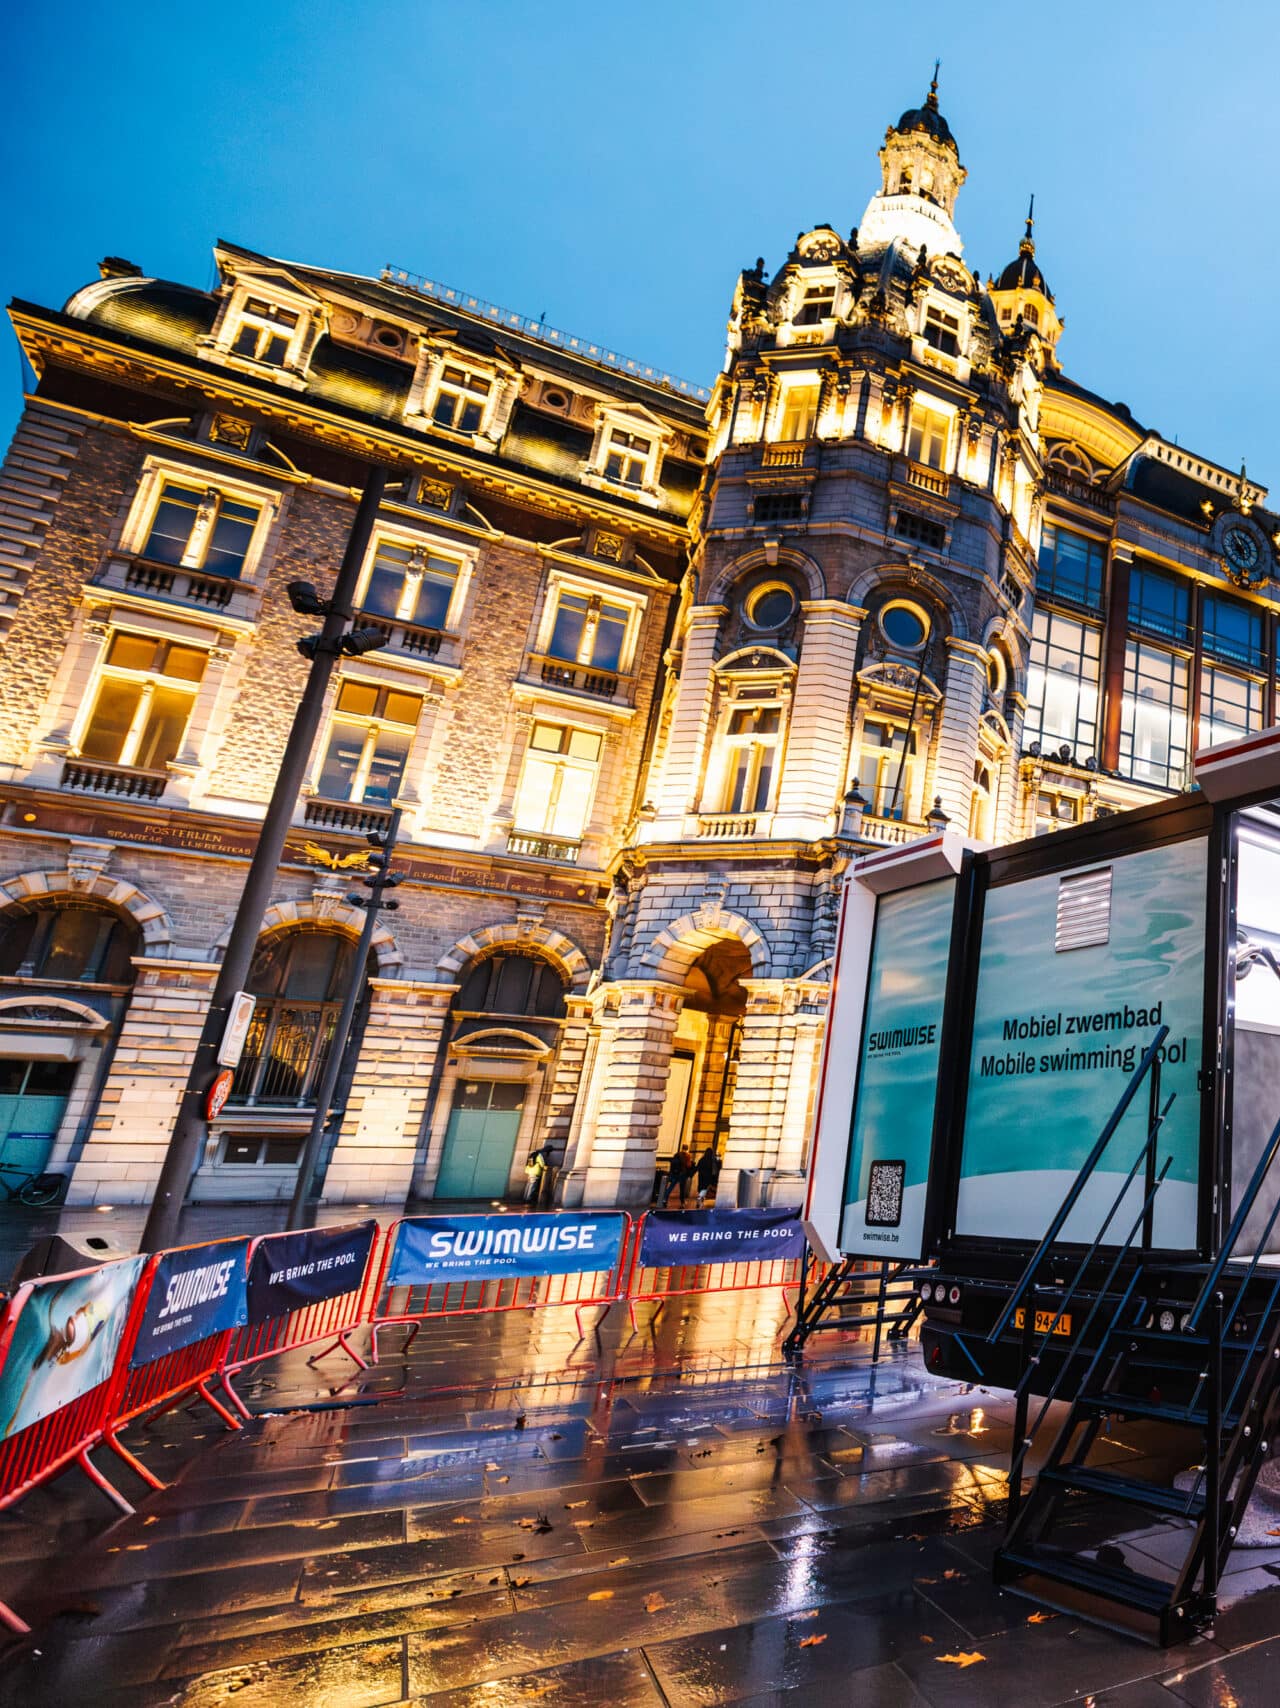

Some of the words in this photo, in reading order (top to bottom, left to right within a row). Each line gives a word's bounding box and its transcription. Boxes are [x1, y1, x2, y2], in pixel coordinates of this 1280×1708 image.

[869, 1024, 936, 1051] SWIMWISE
[1002, 1012, 1062, 1041] Mobiel
[1065, 1001, 1162, 1035] zwembad
[980, 1051, 1036, 1077] Mobile
[1039, 1044, 1136, 1073] swimming
[429, 1225, 597, 1258] SWIMWISE
[669, 1232, 688, 1243] WE
[692, 1231, 733, 1241] BRING
[737, 1230, 760, 1239] THE
[763, 1228, 794, 1238] POOL
[863, 1232, 899, 1243] swimwise.be
[268, 1270, 285, 1285] WE
[286, 1262, 316, 1281] BRING
[317, 1257, 335, 1272] THE
[334, 1252, 356, 1268] POOL
[442, 1260, 471, 1268] BRING
[474, 1258, 491, 1266] THE
[493, 1257, 518, 1265] POOL
[159, 1259, 236, 1318] SWIMWISE
